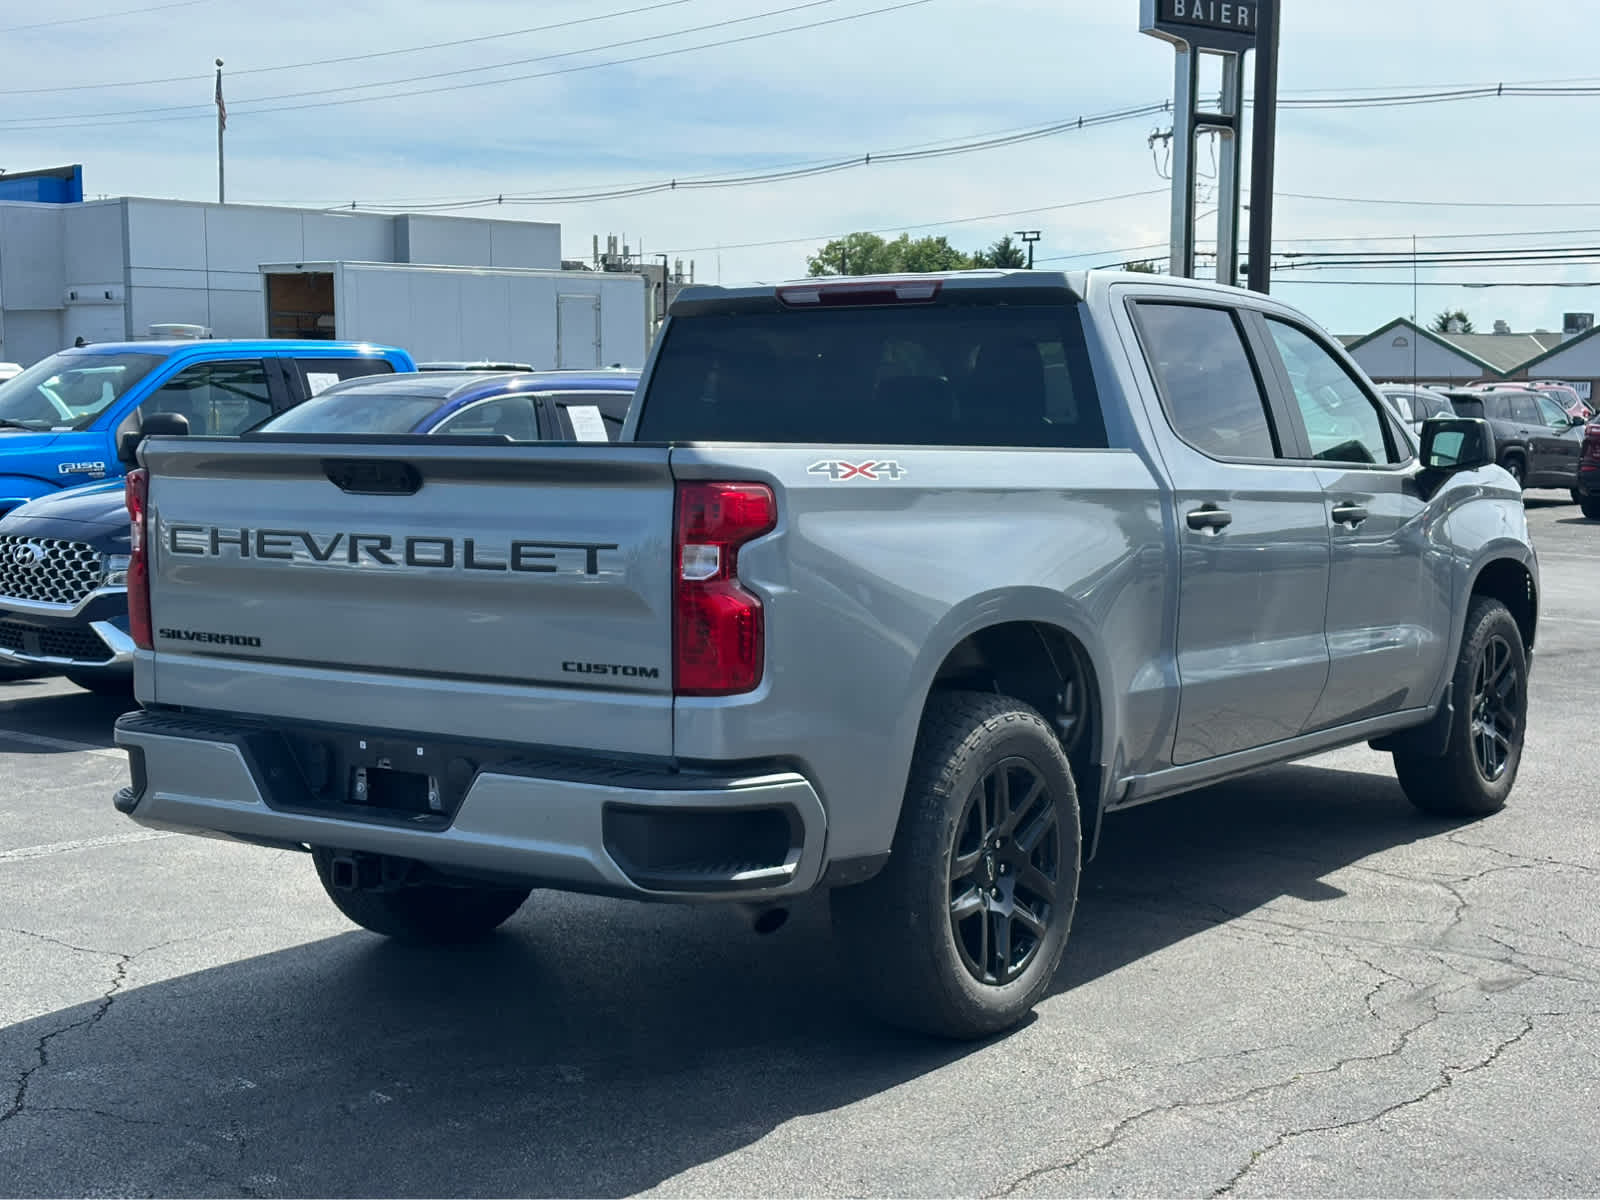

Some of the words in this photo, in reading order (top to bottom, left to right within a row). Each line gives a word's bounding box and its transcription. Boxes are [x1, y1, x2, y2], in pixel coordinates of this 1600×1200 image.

[170, 526, 619, 575] CHEVROLET
[159, 628, 262, 648] SILVERADO
[562, 661, 659, 679] CUSTOM
